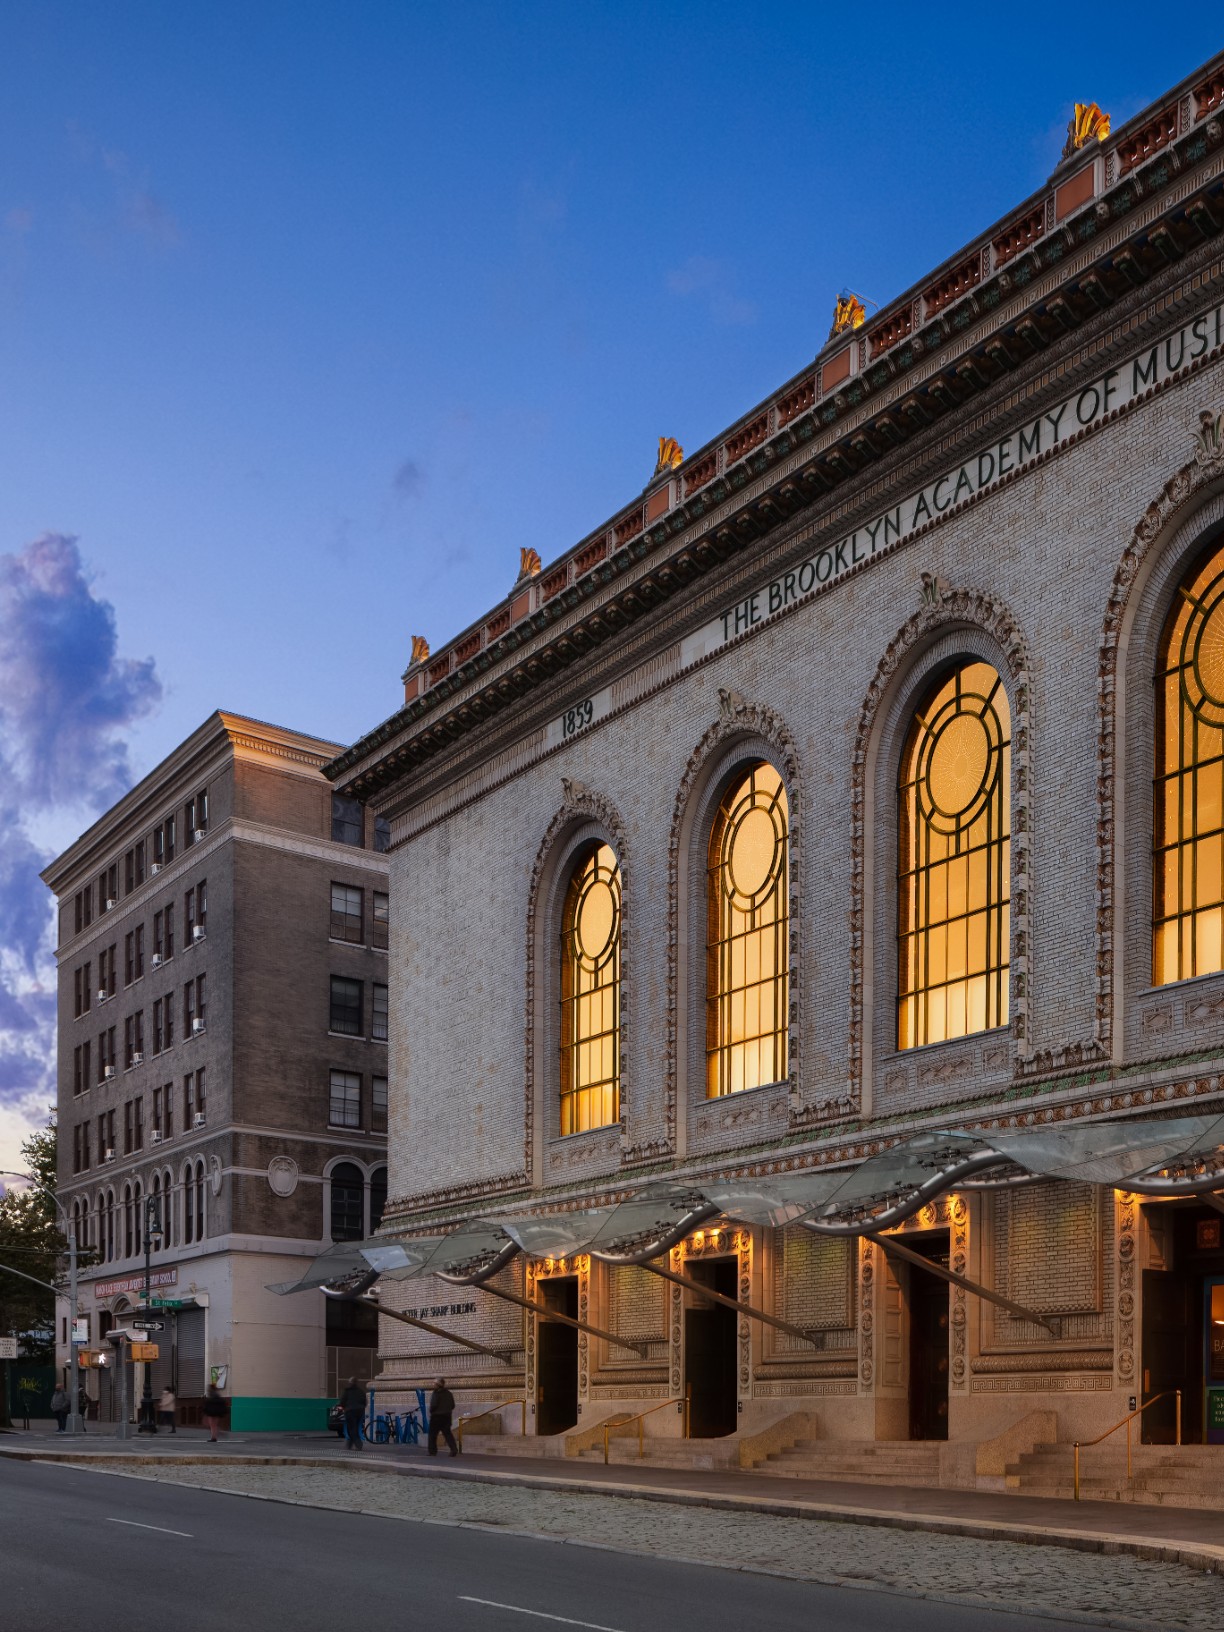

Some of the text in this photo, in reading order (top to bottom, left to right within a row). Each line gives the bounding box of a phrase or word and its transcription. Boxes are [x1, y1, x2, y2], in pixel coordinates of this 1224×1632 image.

[719, 593, 762, 641] THE
[768, 506, 901, 615] BROOKLYN
[912, 402, 1068, 527] ACADEMY
[1076, 370, 1119, 425] OF
[562, 699, 594, 739] 1859
